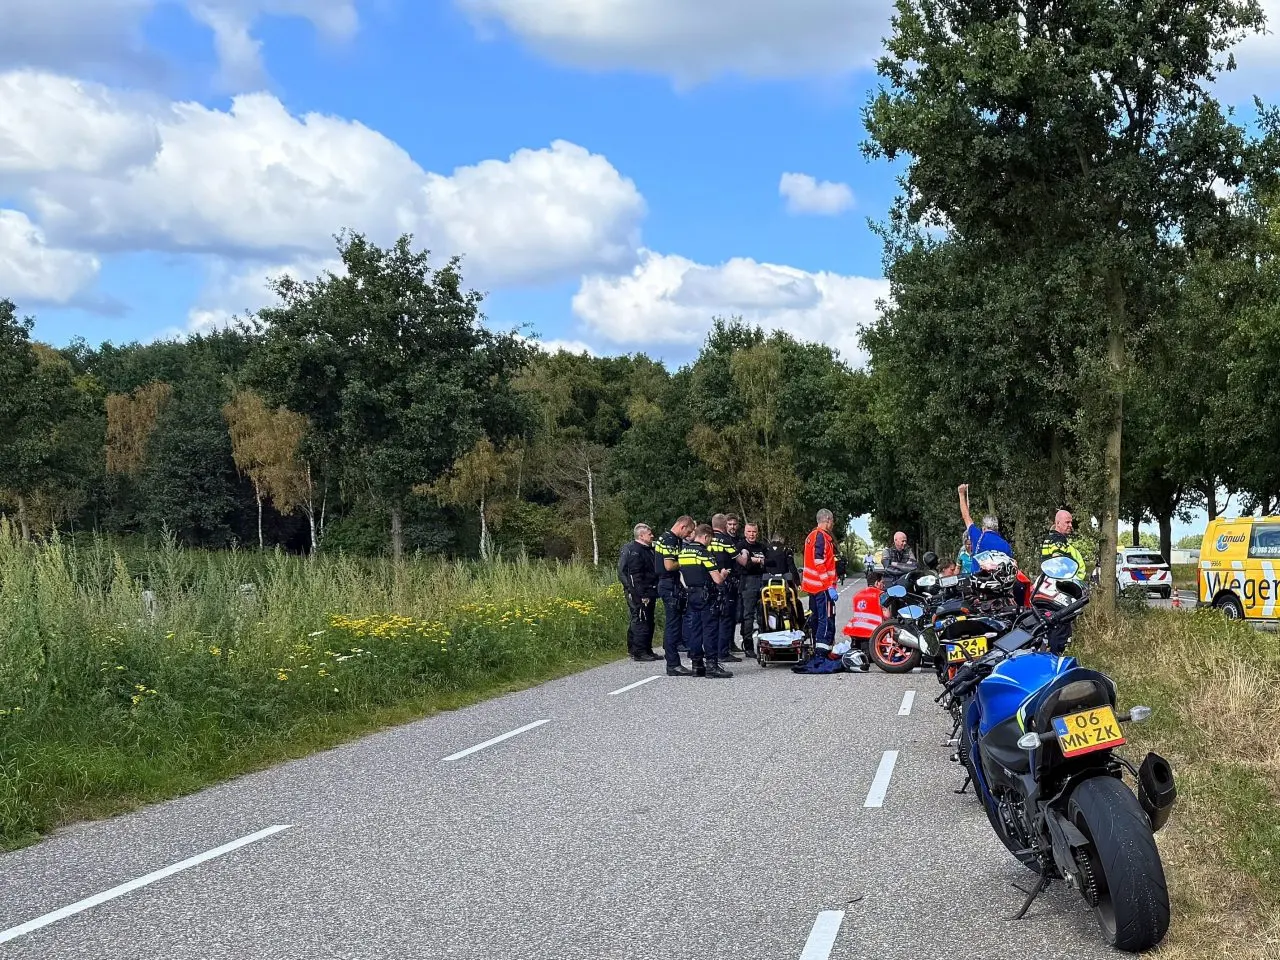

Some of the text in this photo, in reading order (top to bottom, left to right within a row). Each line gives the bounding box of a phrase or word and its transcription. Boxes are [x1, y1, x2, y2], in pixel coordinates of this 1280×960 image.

[1222, 533, 1246, 543] anwb
[962, 639, 978, 649] 94
[949, 646, 985, 659] MTSH
[1075, 712, 1100, 728] 06
[1061, 724, 1118, 750] MN-ZK
